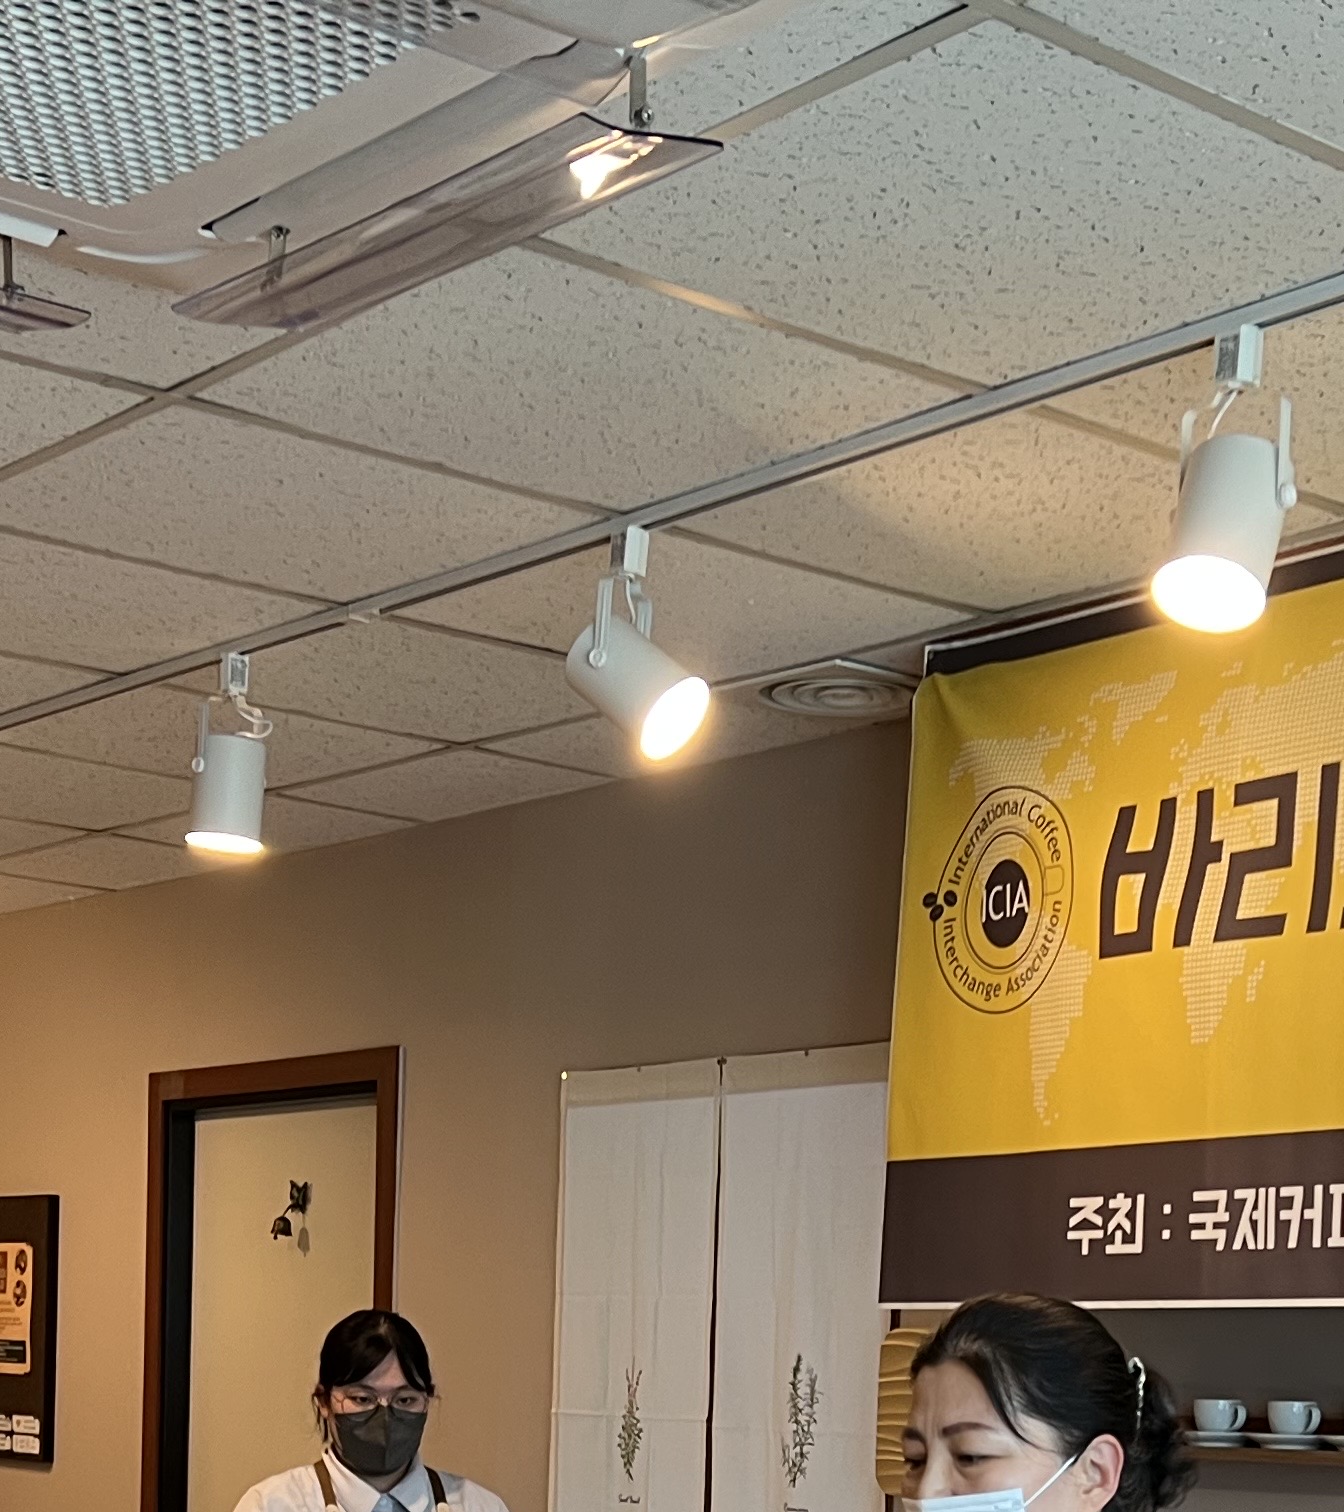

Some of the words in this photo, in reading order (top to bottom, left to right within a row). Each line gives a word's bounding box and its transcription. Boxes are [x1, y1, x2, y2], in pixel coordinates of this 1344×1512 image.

[948, 796, 1027, 886] International
[1028, 803, 1062, 863] Coffee
[981, 878, 1030, 924] ICIA
[943, 916, 1002, 1002] Interchange
[1005, 899, 1063, 997] Association
[1066, 1193, 1146, 1257] 주최
